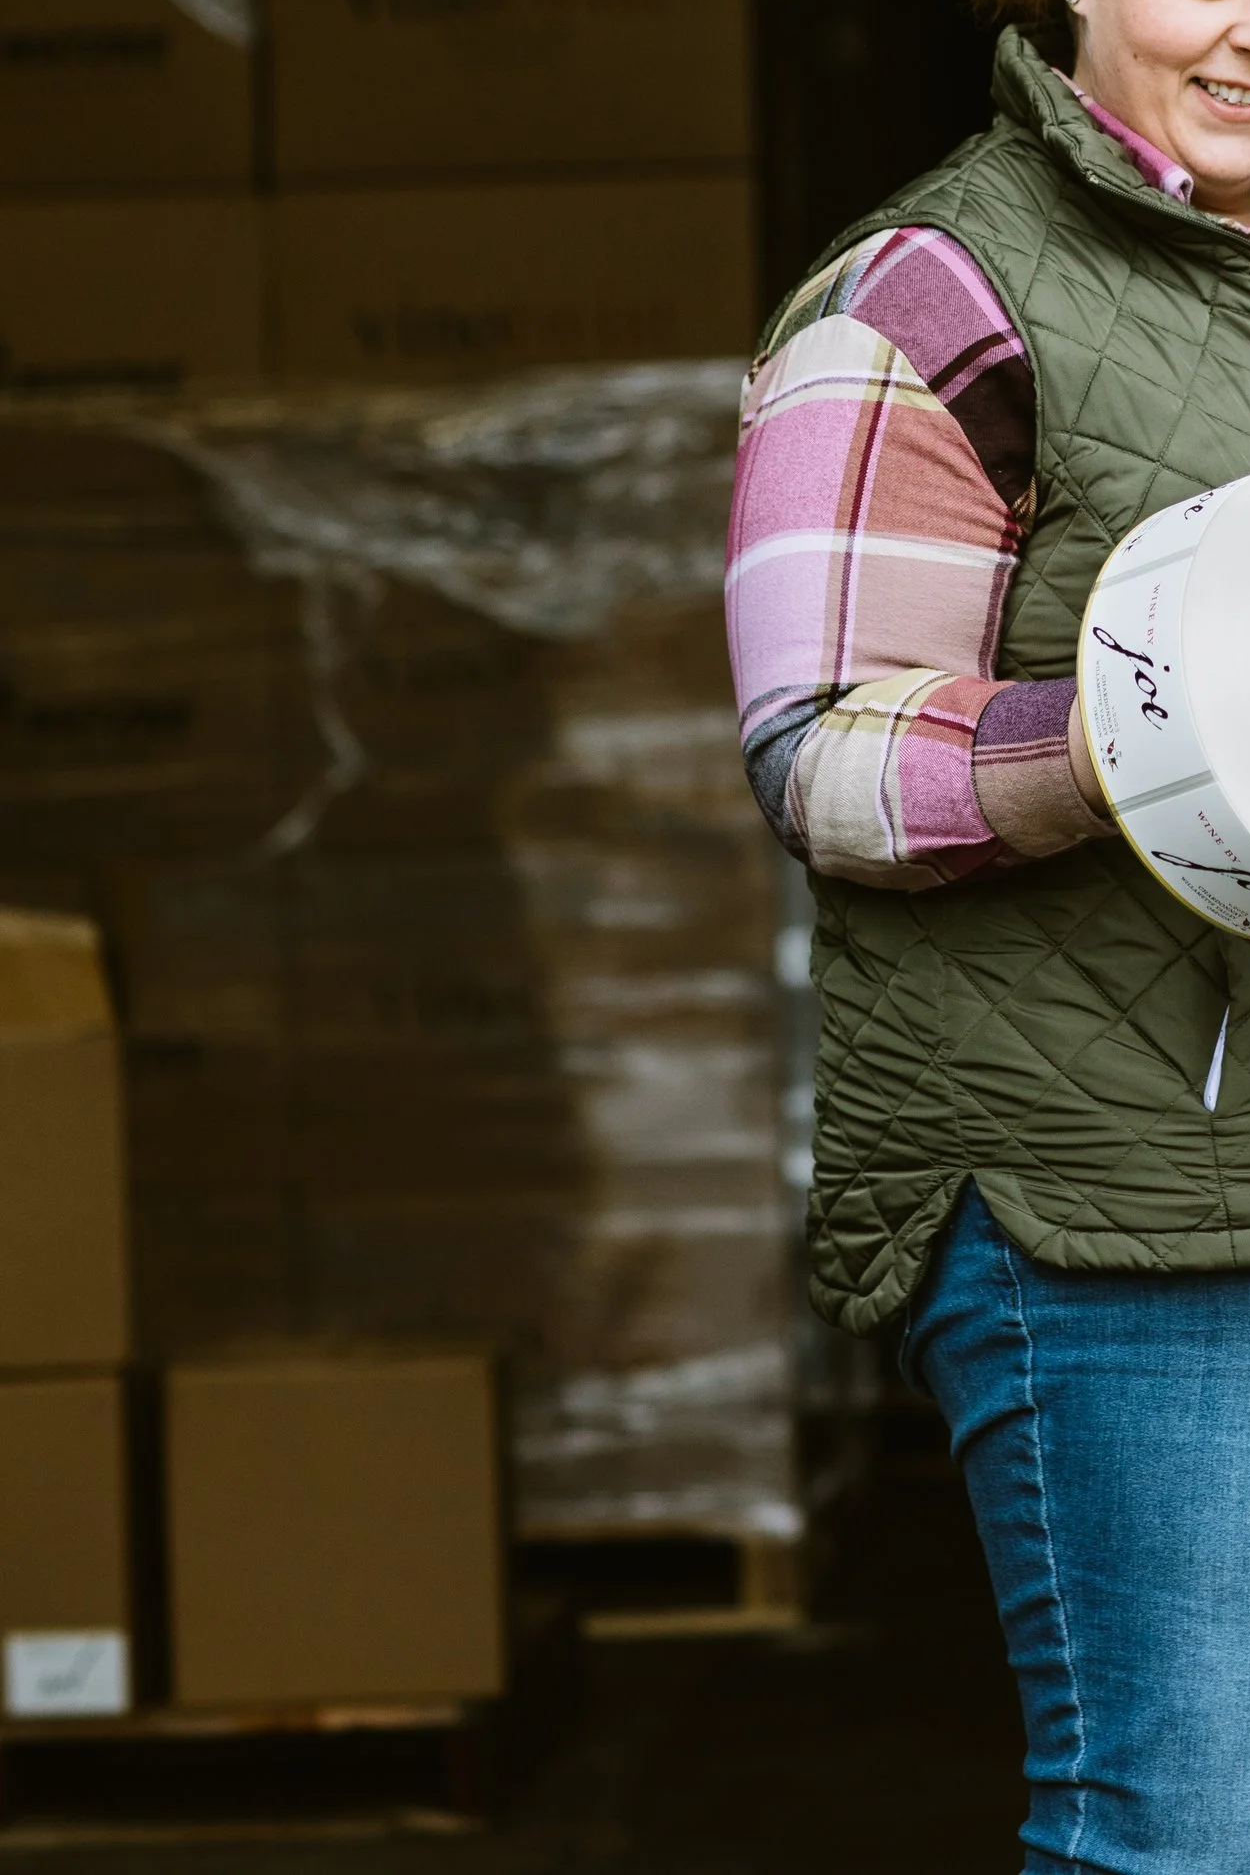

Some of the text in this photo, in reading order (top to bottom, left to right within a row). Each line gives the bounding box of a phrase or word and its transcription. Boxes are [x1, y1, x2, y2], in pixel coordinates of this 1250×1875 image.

[1147, 583, 1162, 645] WINE BY
[1093, 626, 1171, 731] joe
[1101, 674, 1115, 735] CHARDONNAY
[1197, 810, 1242, 865] WINE BY
[1197, 884, 1245, 918] CHARDONNAY
